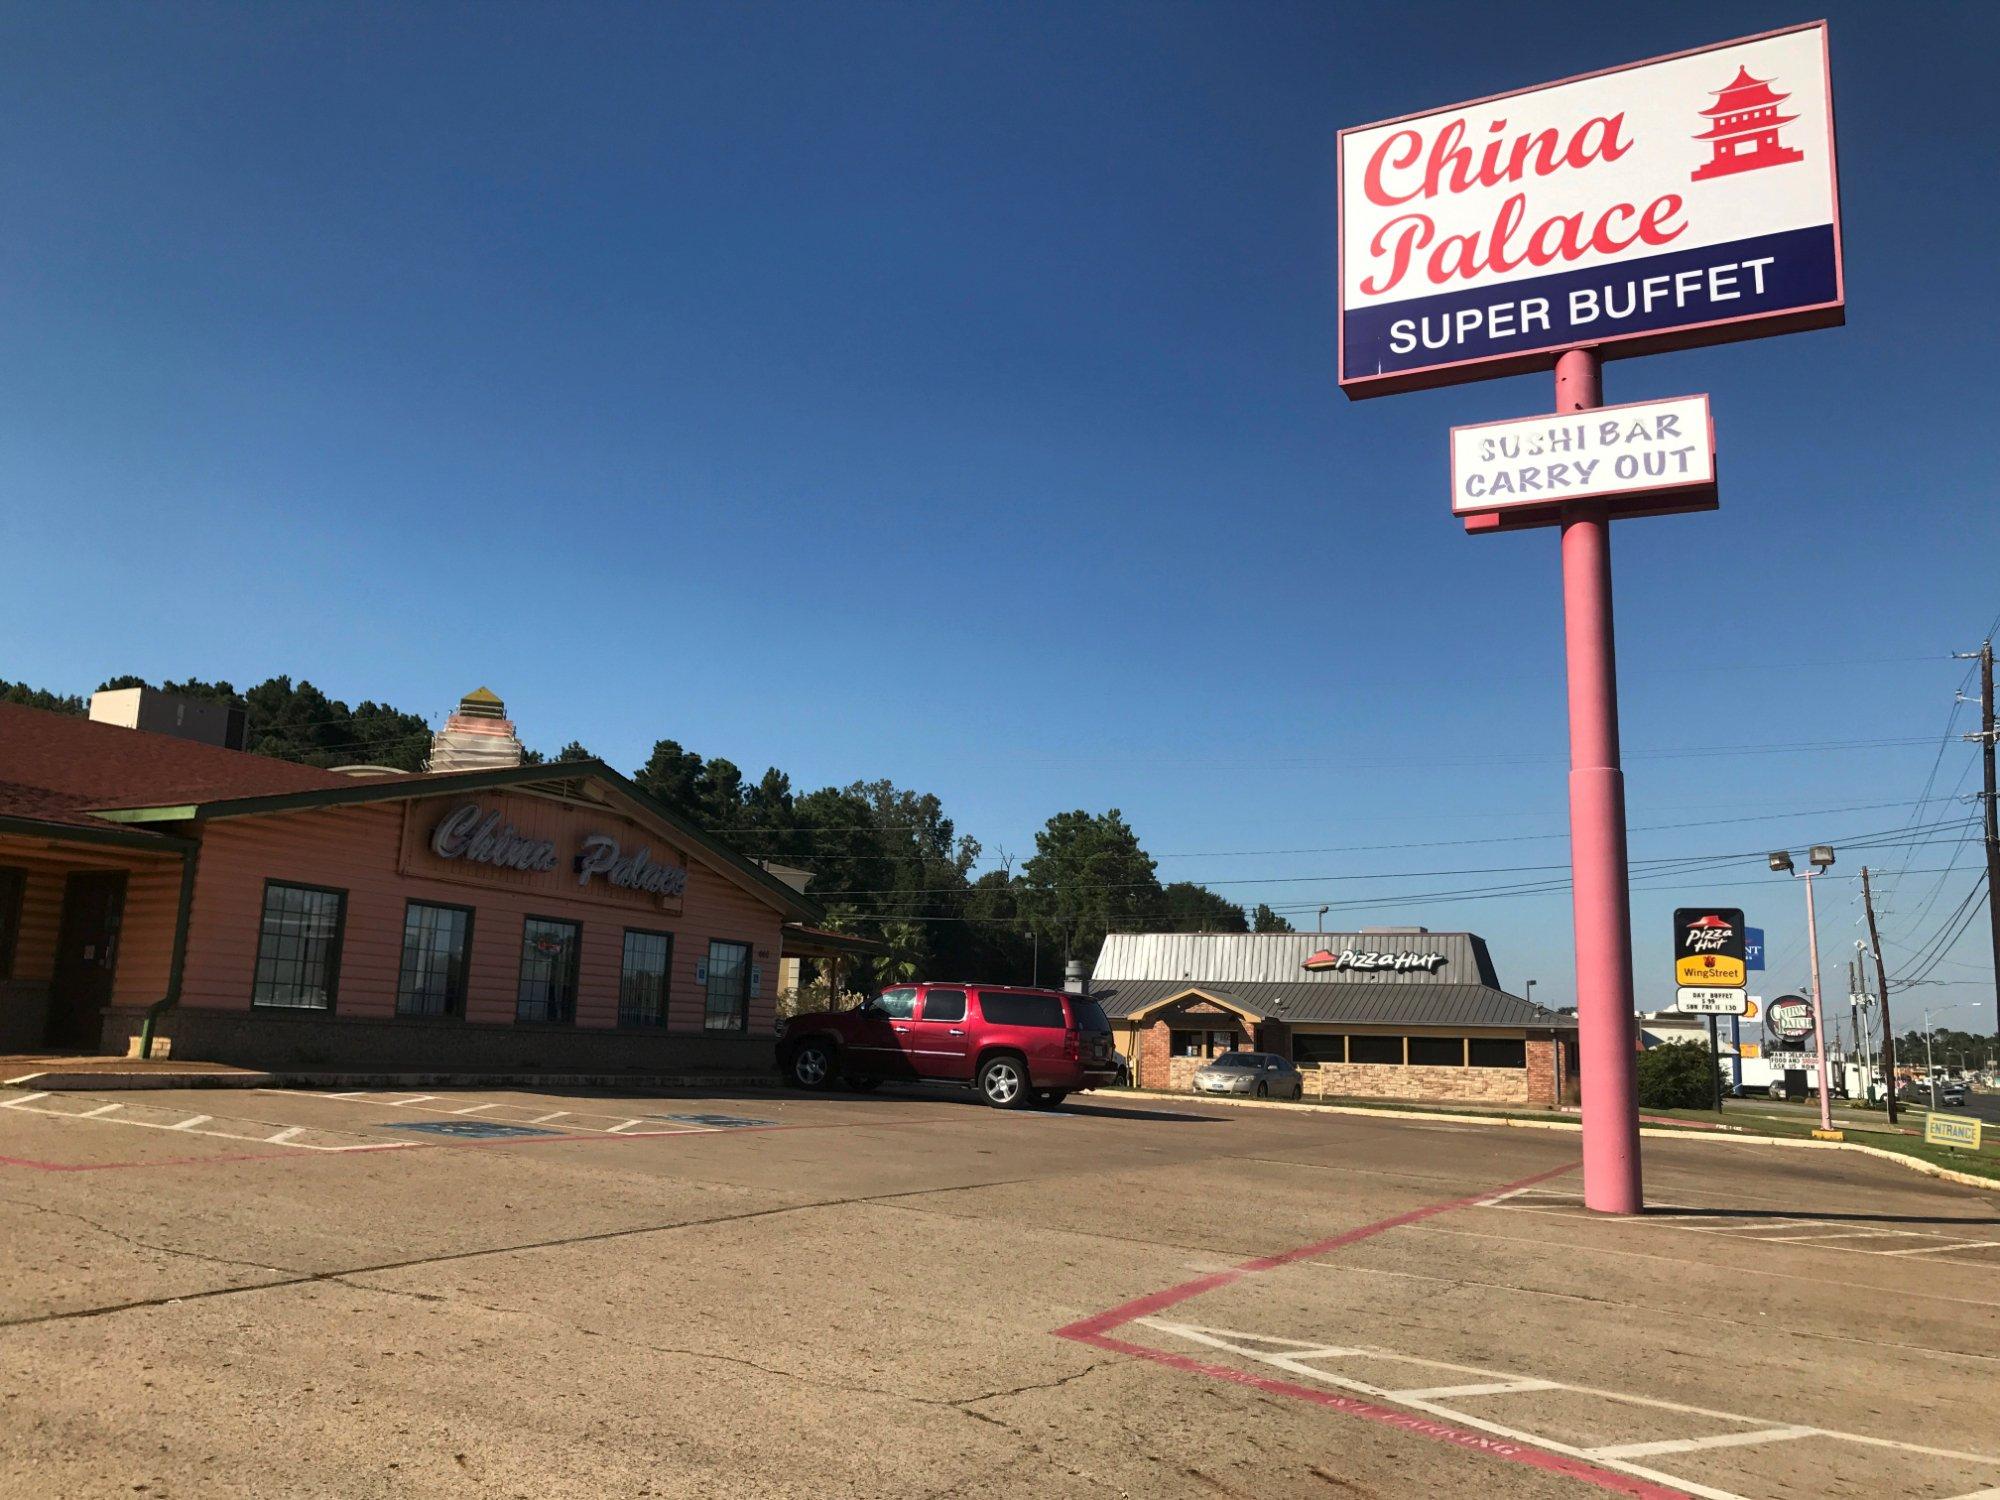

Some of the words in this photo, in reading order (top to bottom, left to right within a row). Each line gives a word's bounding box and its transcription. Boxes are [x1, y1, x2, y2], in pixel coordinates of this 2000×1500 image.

[1363, 110, 1635, 207] China
[1359, 192, 1689, 296] Palace
[1389, 297, 1551, 354] SUPER
[1569, 256, 1776, 326] BUFFET
[1480, 425, 1585, 462] SUSHI
[1599, 414, 1682, 447] BAR
[1465, 459, 1600, 498] CARRY
[1614, 445, 1697, 480] OUT
[431, 803, 560, 872] China
[573, 833, 689, 897] Palace
[1335, 949, 1395, 969] Pizza
[1395, 952, 1445, 970] Hut
[1686, 926, 1733, 946] Pizza
[1695, 938, 1727, 952] Hut
[1684, 967, 1739, 979] WingStreet
[1930, 1122, 1977, 1140] ENTRANCE
